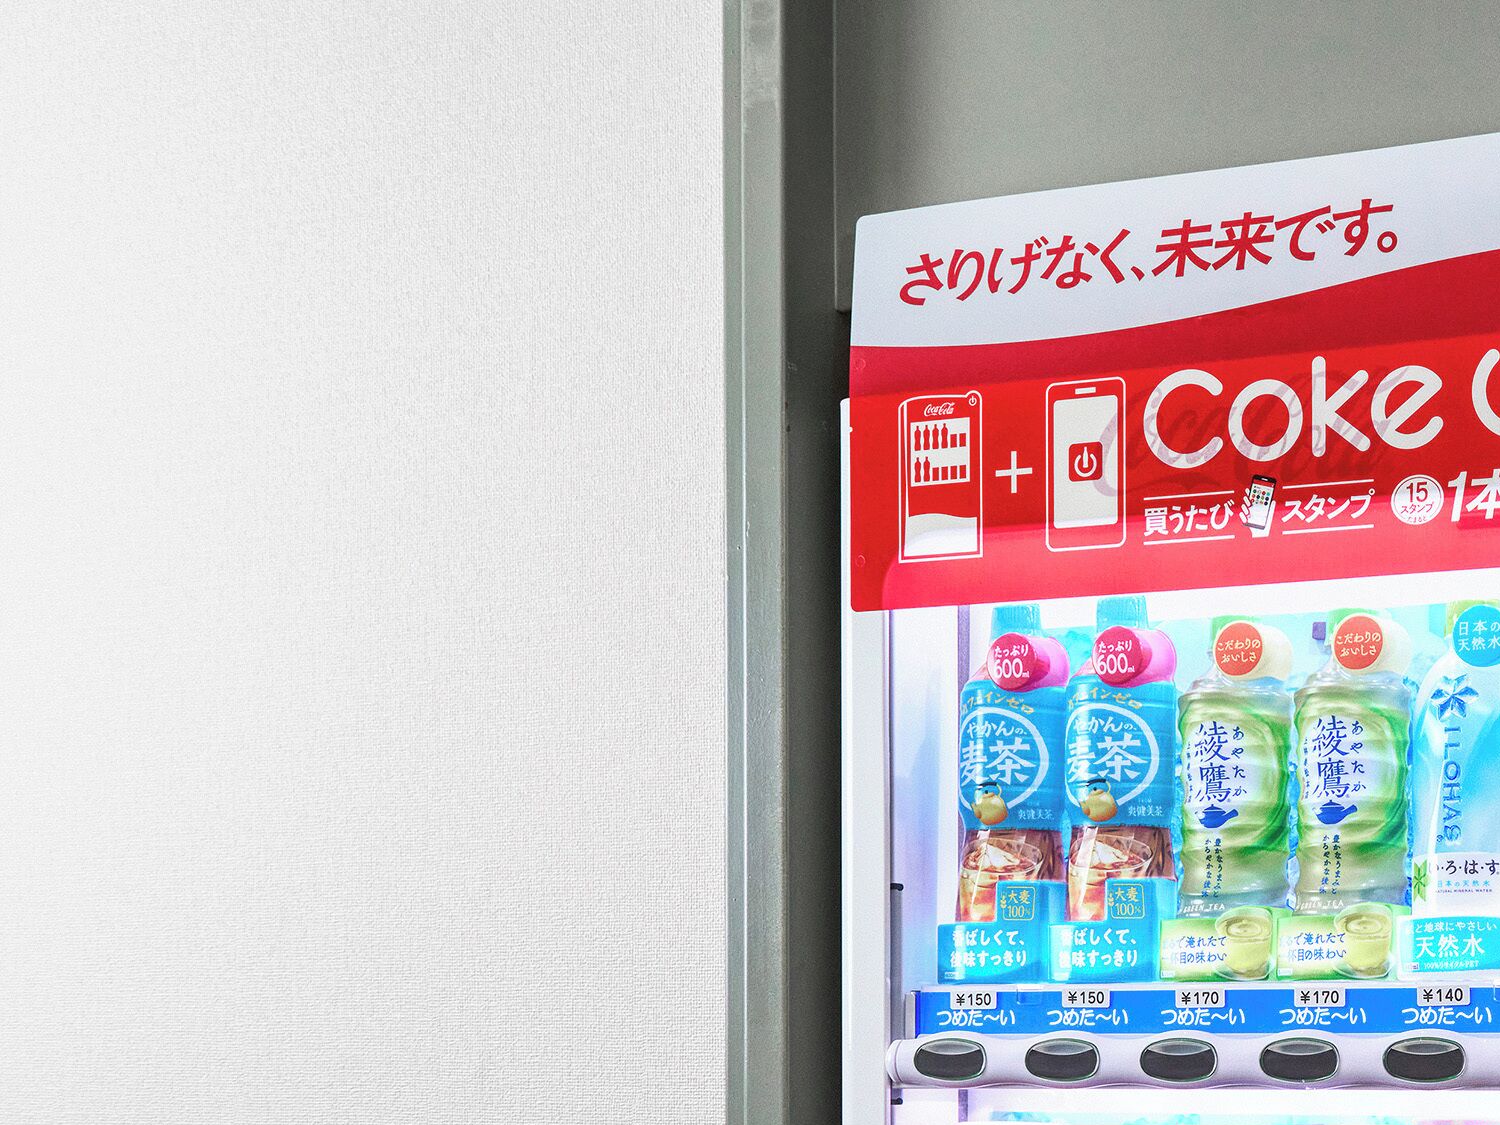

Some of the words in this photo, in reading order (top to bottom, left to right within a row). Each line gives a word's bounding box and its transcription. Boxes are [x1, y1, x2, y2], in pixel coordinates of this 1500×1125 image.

[898, 197, 1400, 308] さりげなく、未来です。
[1142, 355, 1445, 470] Coke
[1406, 482, 1428, 502] 15
[1282, 488, 1375, 523] スタンプ
[1144, 499, 1233, 536] 買うたび
[1458, 621, 1500, 636] 日本の
[1218, 638, 1261, 651] こだわりの
[1336, 632, 1381, 646] こだわりの
[1458, 636, 1500, 651] 天然水
[994, 643, 1029, 658] たっぷり
[1099, 640, 1133, 654] たっぷり
[1340, 646, 1377, 657] おいしさ
[1221, 651, 1258, 663] おいしさ
[960, 737, 1037, 787] 麦茶
[1068, 733, 1148, 783] 麦茶
[1416, 934, 1485, 958] 天然水
[956, 992, 992, 1006] ¥150
[1068, 991, 1105, 1005] ¥150
[1181, 991, 1219, 1005] ¥170
[1300, 990, 1339, 1004] ¥170
[1422, 988, 1463, 1002] ¥140
